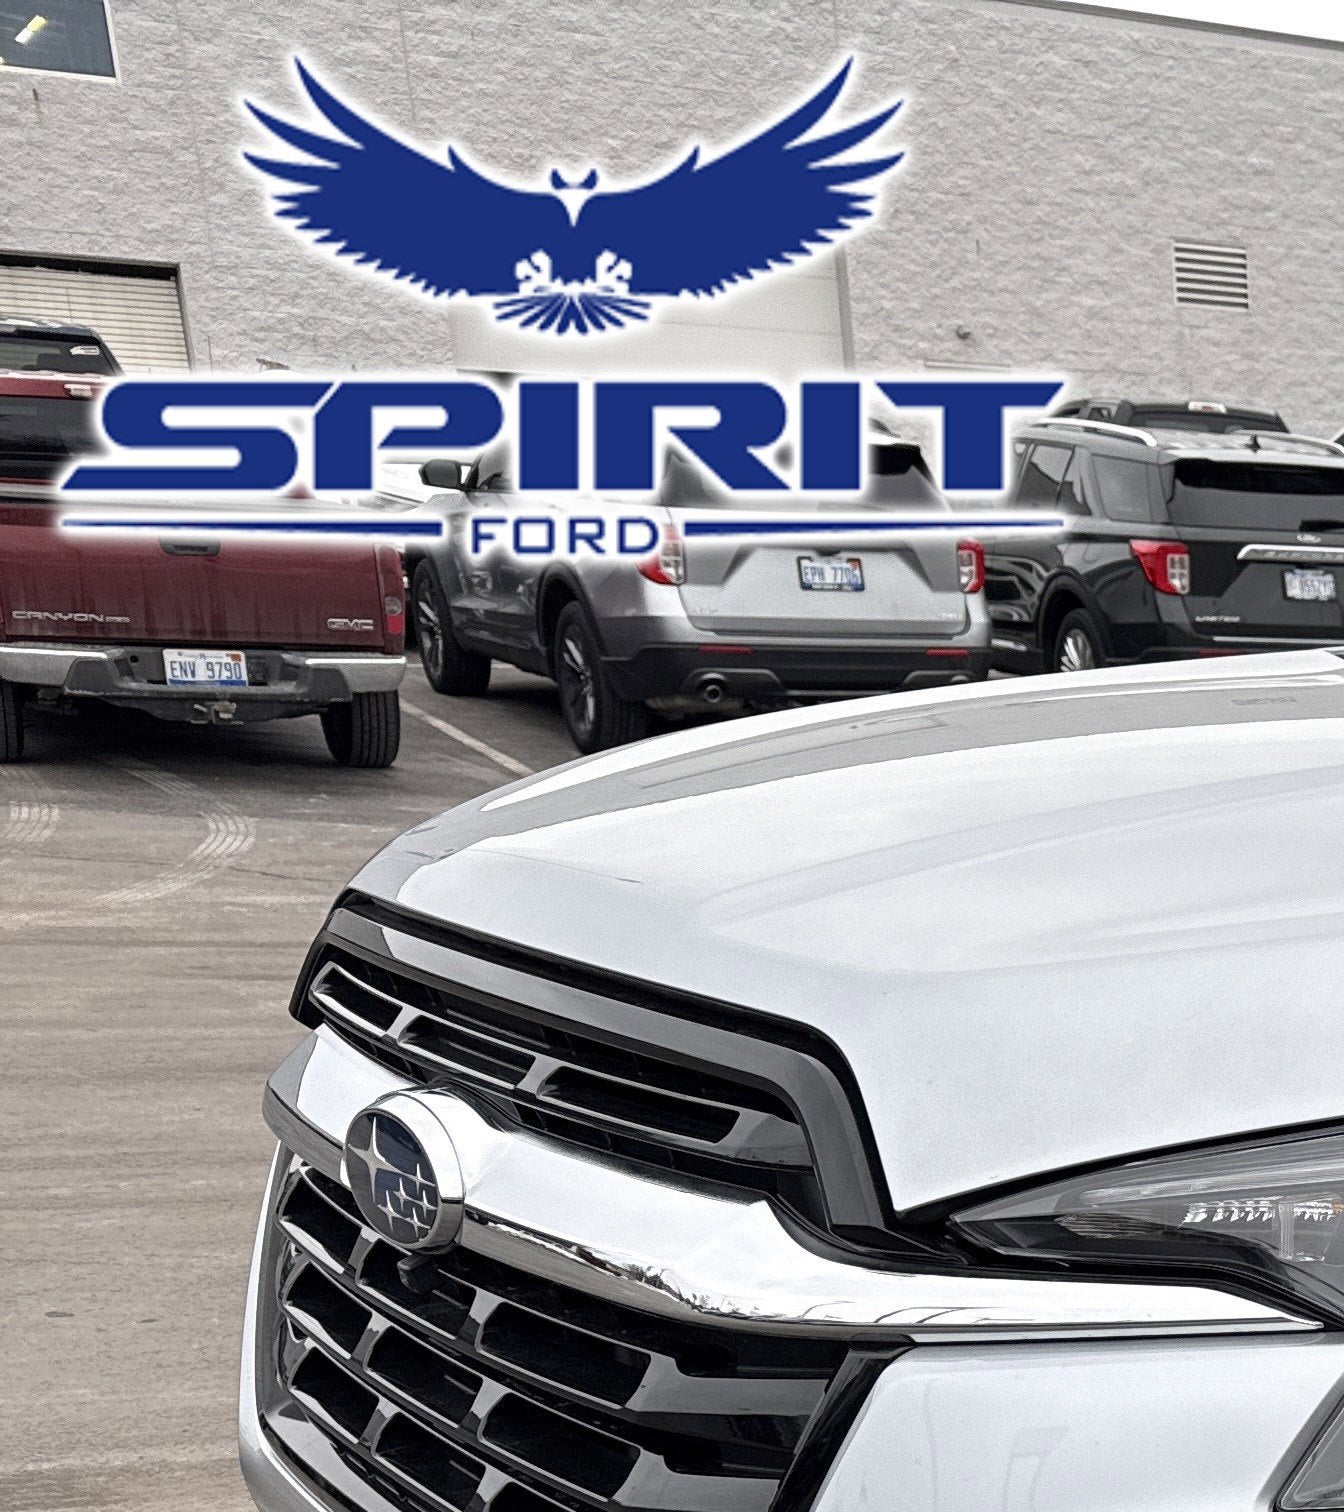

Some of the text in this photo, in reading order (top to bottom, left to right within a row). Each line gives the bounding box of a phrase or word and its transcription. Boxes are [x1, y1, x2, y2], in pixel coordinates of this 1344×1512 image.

[11, 609, 104, 623] CANYON
[326, 617, 374, 631] GMC
[169, 660, 243, 680] ENV 9790
